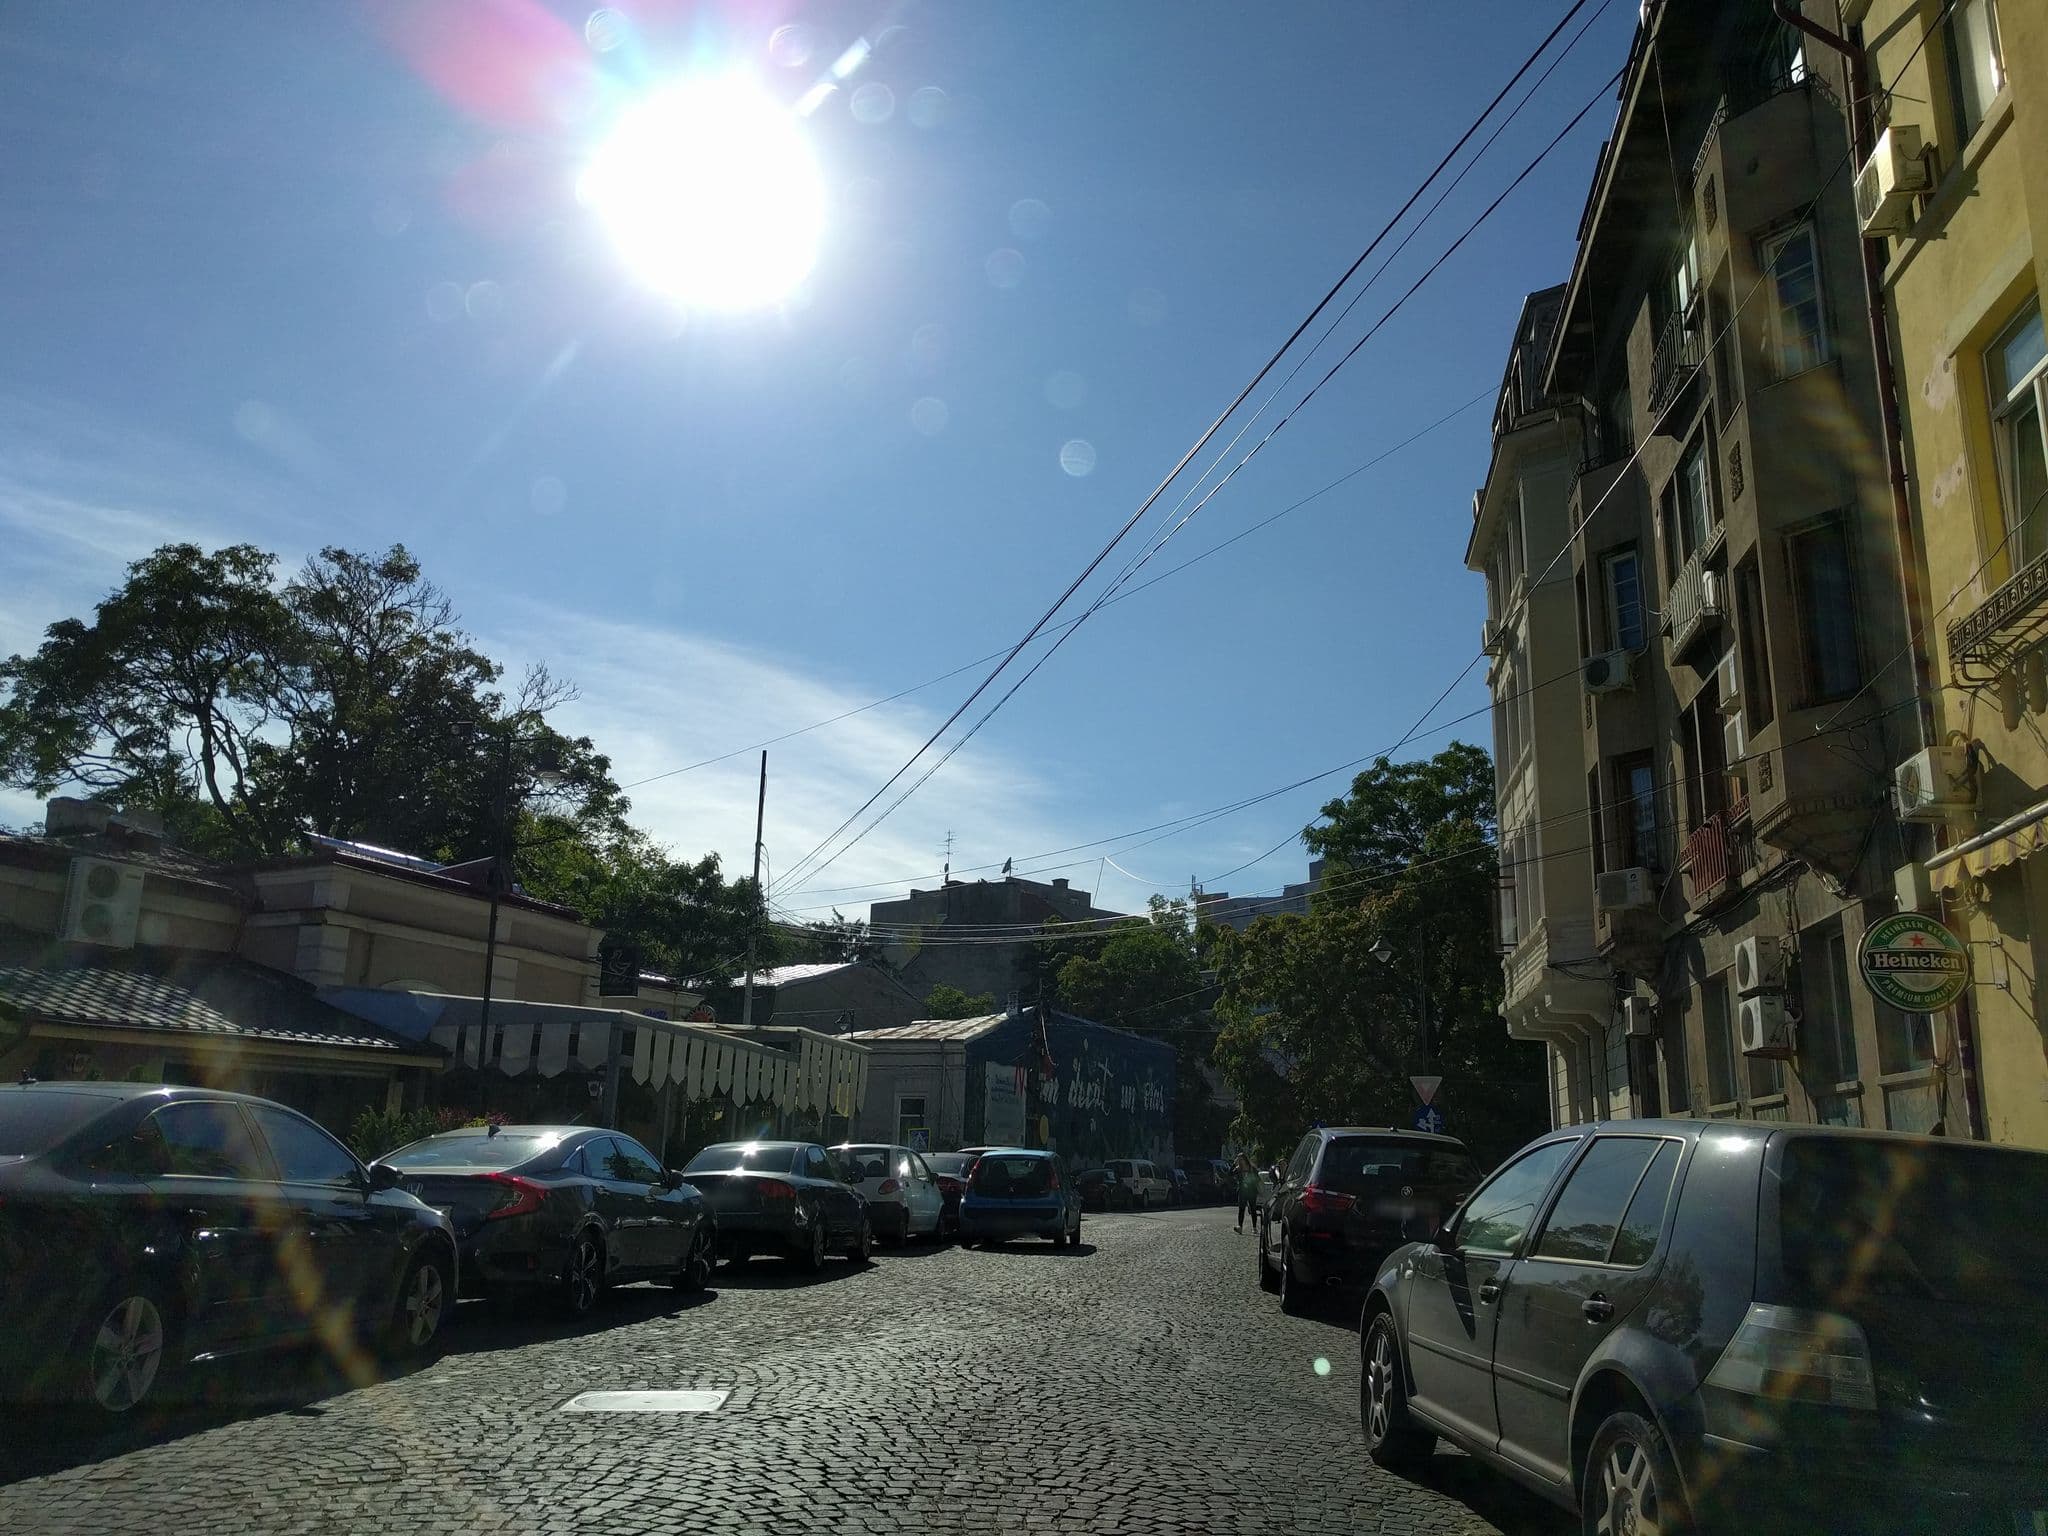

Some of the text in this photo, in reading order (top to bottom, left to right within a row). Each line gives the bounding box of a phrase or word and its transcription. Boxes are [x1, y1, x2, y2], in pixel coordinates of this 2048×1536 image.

[1880, 920, 1923, 942] HEINEKEN
[1873, 953, 1960, 969] Heineken
[1881, 979, 1955, 1003] PREMIUM QUALITY
